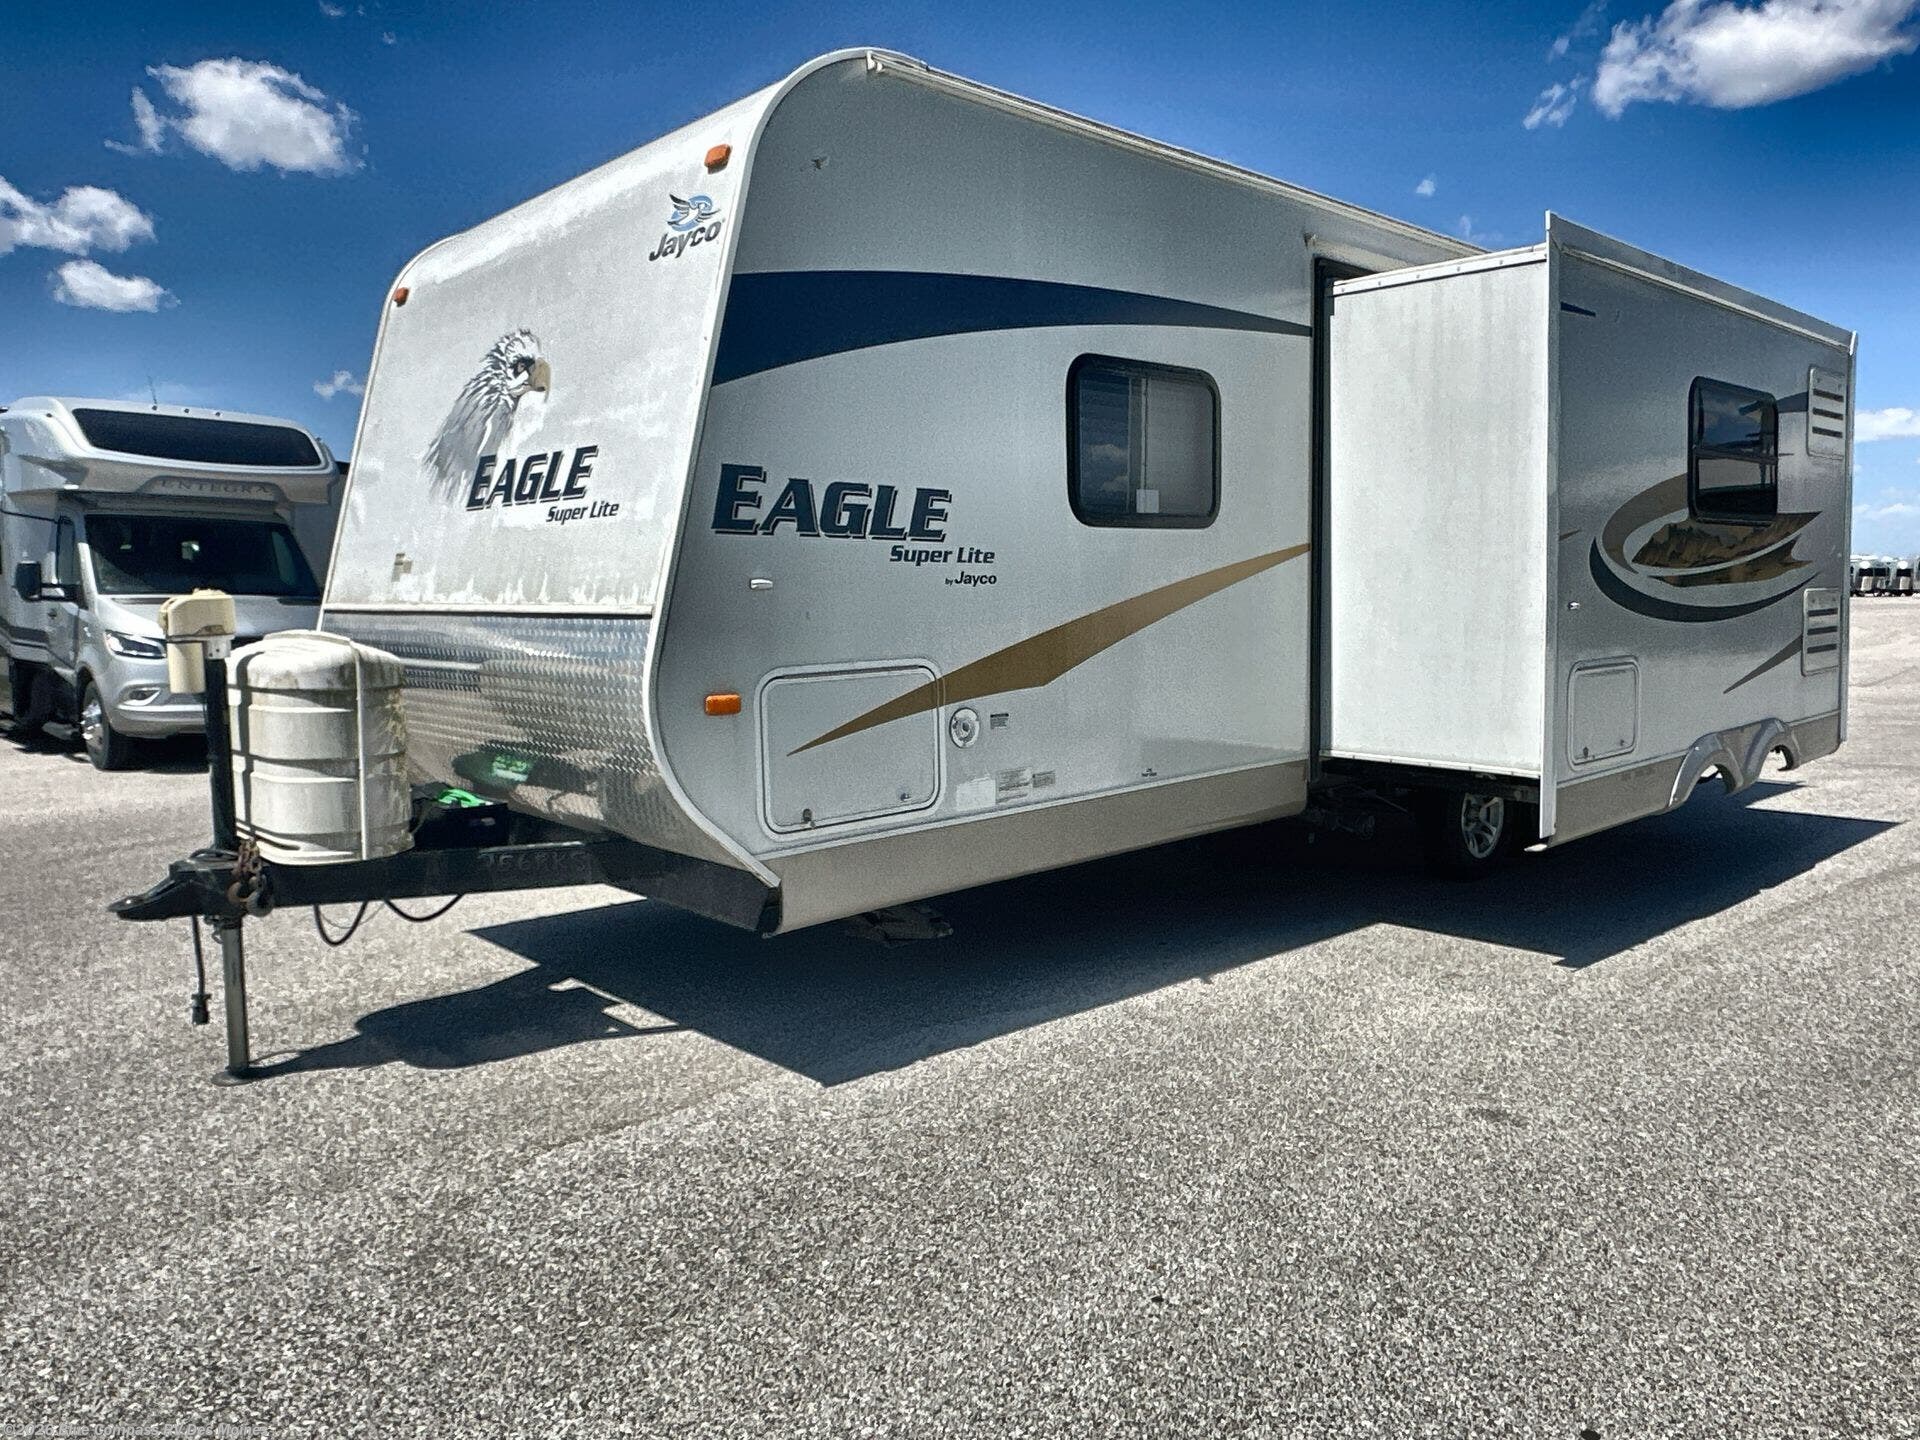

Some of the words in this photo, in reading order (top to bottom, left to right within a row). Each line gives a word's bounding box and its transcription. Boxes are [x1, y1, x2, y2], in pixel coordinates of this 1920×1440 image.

[649, 221, 721, 261] Jayco
[466, 445, 599, 511] EAGLE
[546, 506, 588, 525] Super
[589, 501, 619, 518] Lite
[711, 463, 952, 542] EAGLE
[889, 545, 953, 566] Super
[956, 547, 995, 563] Lite
[954, 571, 997, 587] Jayco
